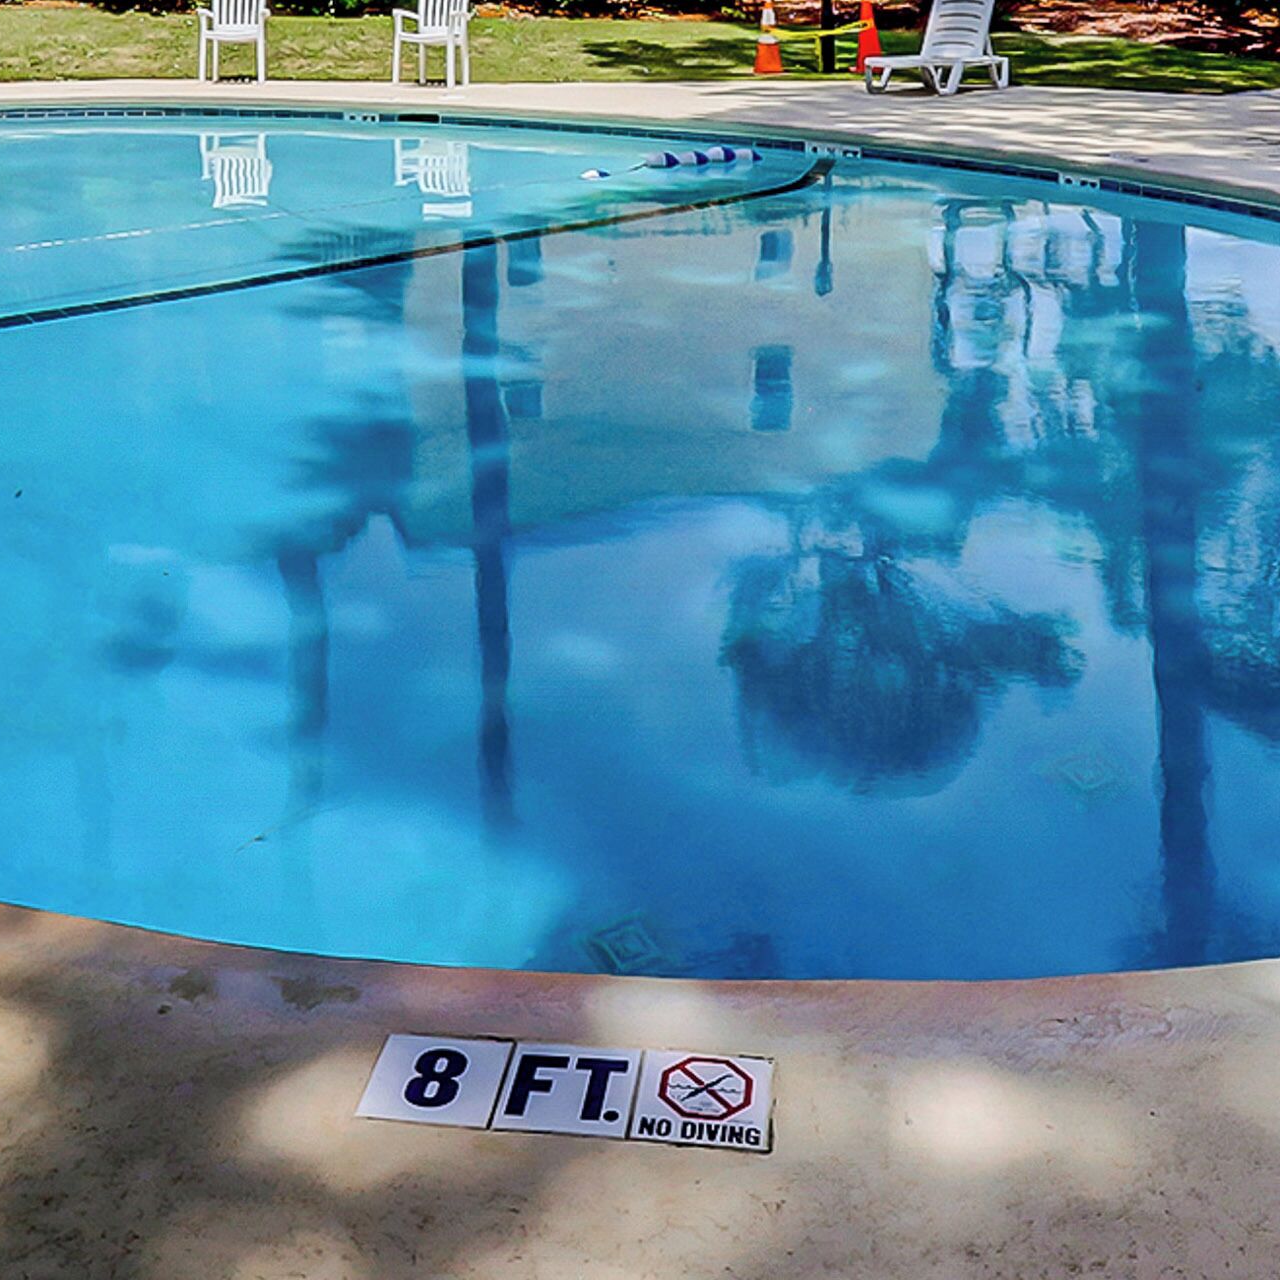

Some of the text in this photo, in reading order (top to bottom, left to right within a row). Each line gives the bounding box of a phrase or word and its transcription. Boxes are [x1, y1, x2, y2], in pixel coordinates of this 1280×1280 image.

[404, 1048, 629, 1123] 8 FT.
[637, 1116, 762, 1147] NO DIVING
